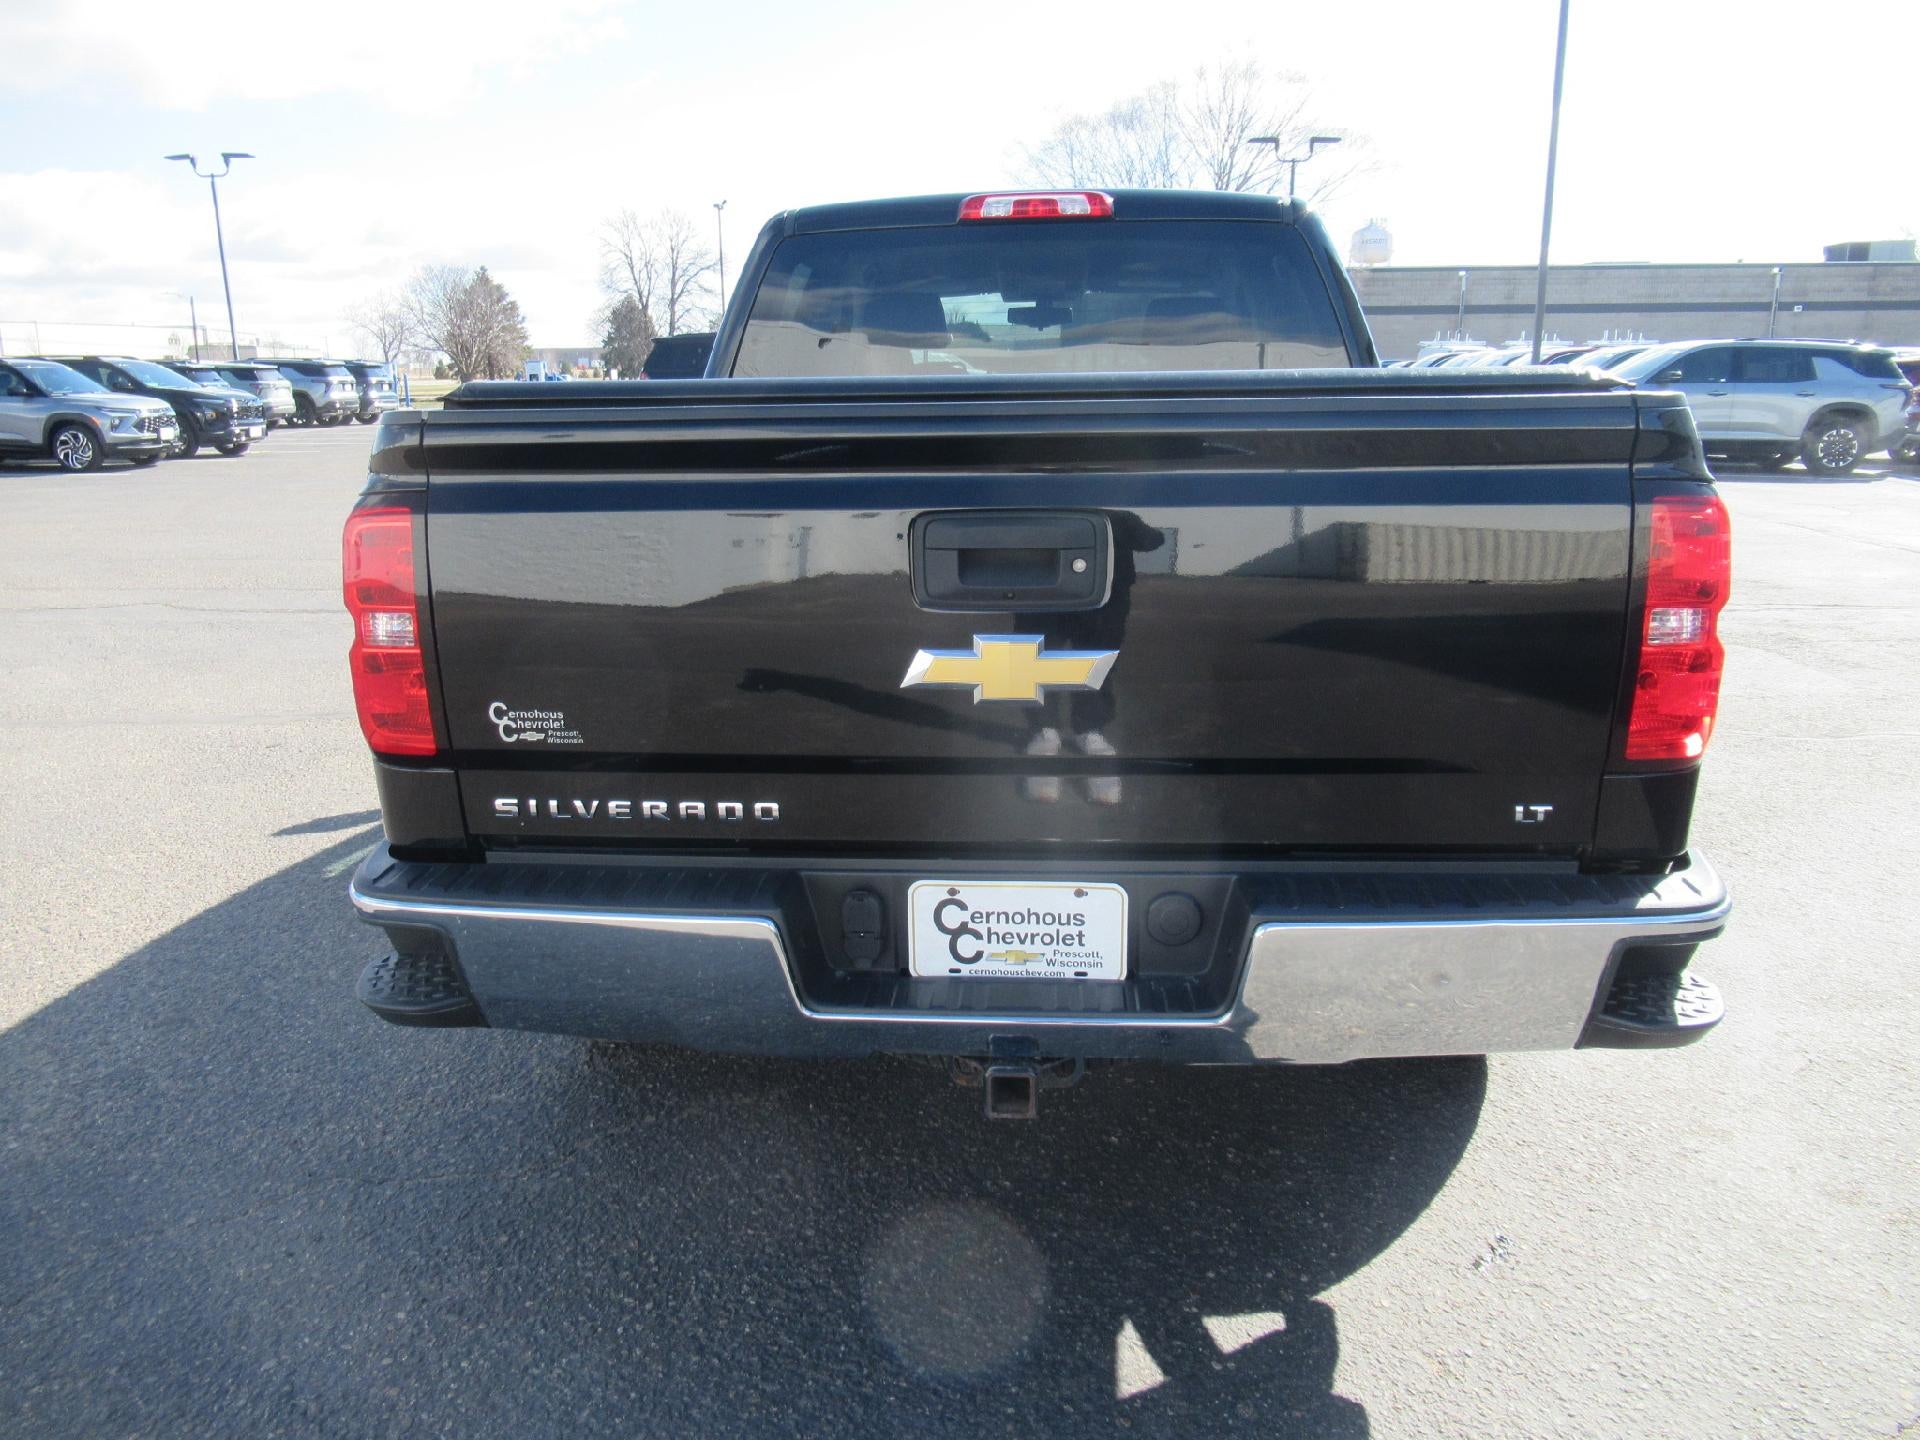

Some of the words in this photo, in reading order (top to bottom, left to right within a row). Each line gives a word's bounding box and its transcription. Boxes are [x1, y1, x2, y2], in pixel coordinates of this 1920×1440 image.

[488, 702, 564, 724] Cernohous
[499, 718, 566, 743] Chevrolet
[494, 798, 781, 821] SILVERADO
[1514, 804, 1554, 823] LT
[933, 897, 1086, 935] Cernohous
[949, 926, 1086, 964] Chevrolet
[968, 967, 1066, 978] cernohouschev.com
[1045, 958, 1104, 969] Wisconsin
